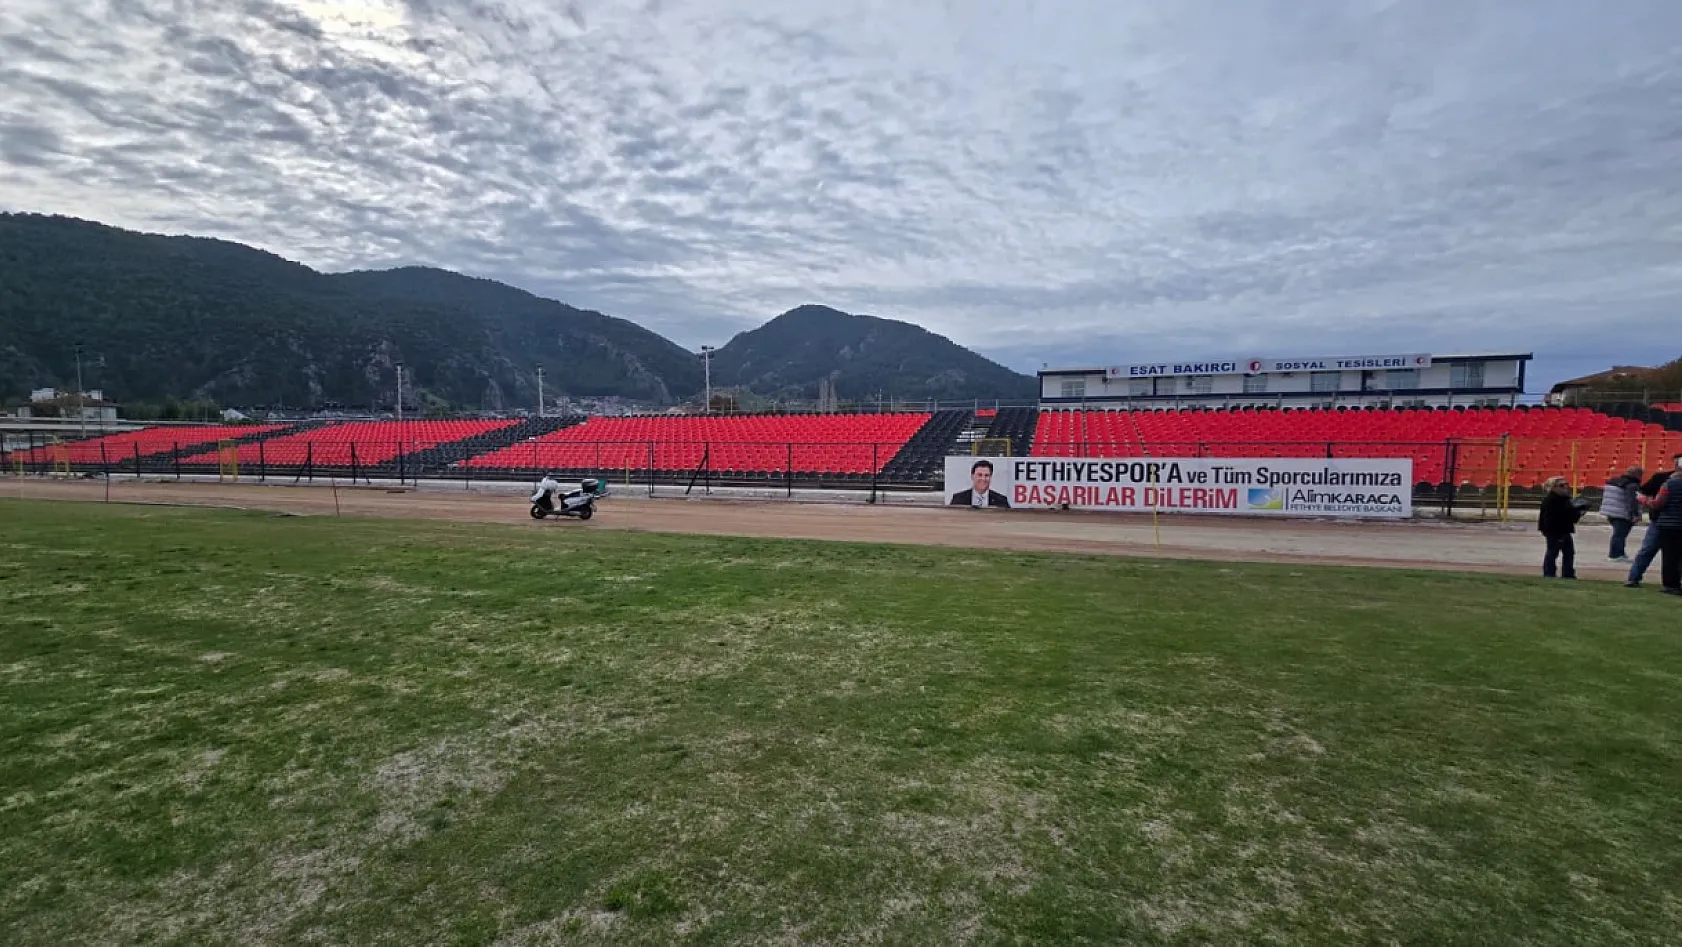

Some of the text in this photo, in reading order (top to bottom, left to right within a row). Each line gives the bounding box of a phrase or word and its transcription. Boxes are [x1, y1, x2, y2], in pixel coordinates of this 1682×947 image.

[1130, 362, 1236, 375] ESAT BAKIRCI
[1275, 361, 1326, 370] SOSYAL
[1188, 470, 1208, 484] ve
[1211, 466, 1251, 484] Tüm
[1256, 467, 1402, 487] Sporcularımıza
